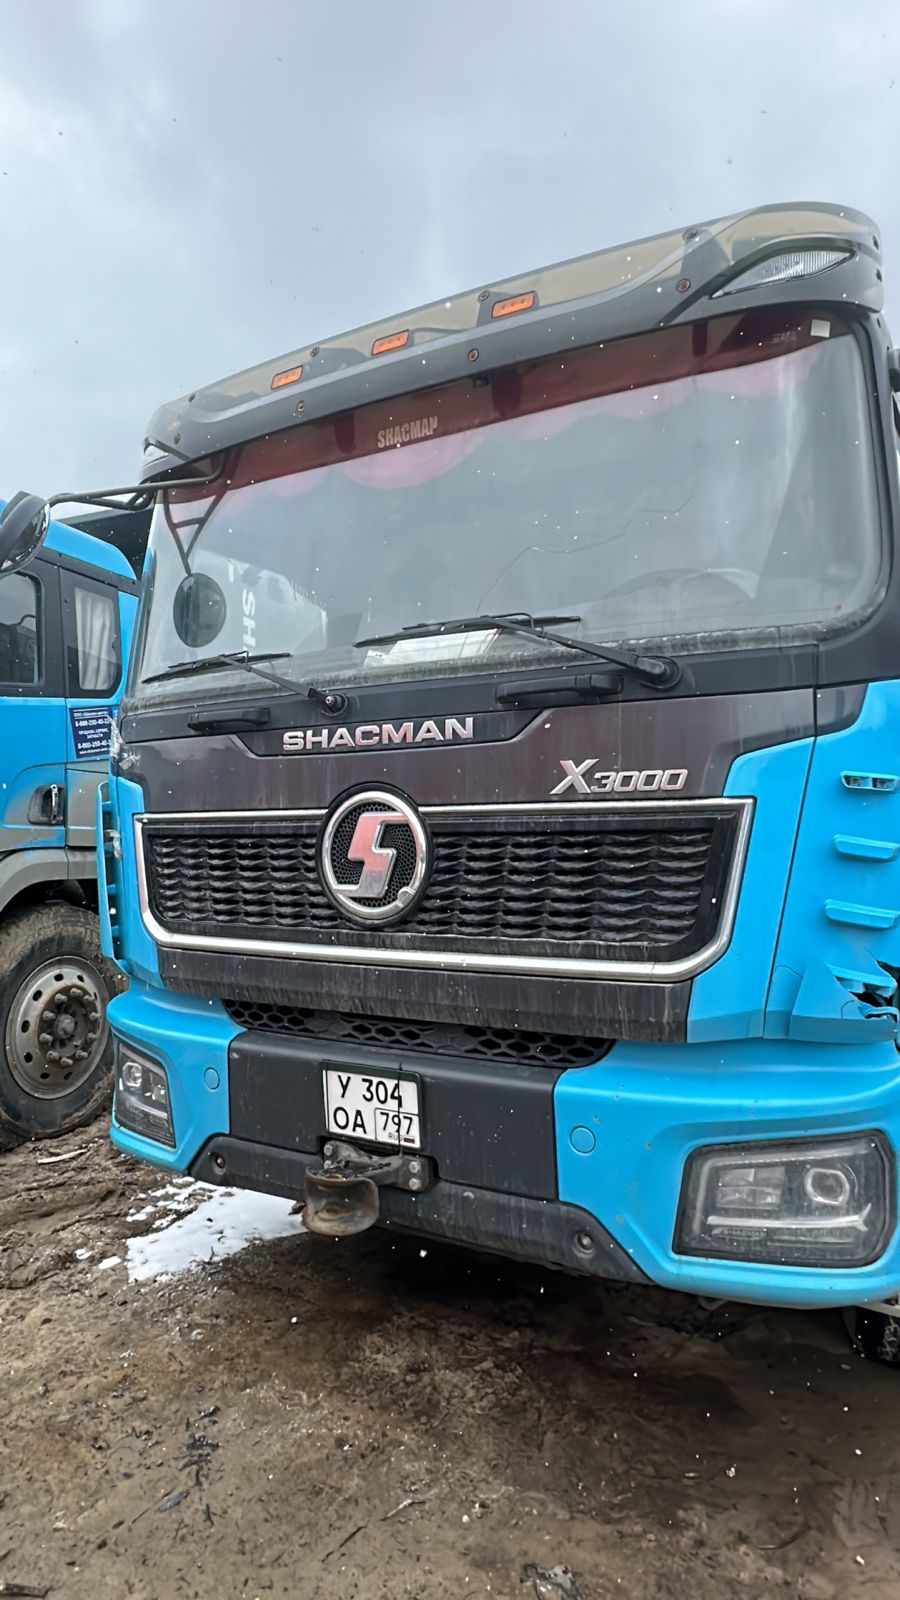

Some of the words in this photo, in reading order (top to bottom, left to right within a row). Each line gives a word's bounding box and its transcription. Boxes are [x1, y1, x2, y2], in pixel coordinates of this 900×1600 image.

[283, 717, 474, 750] SHACMAN
[549, 758, 688, 794] X3000
[361, 1078, 402, 1108] 304
[380, 1111, 413, 1135] 797
